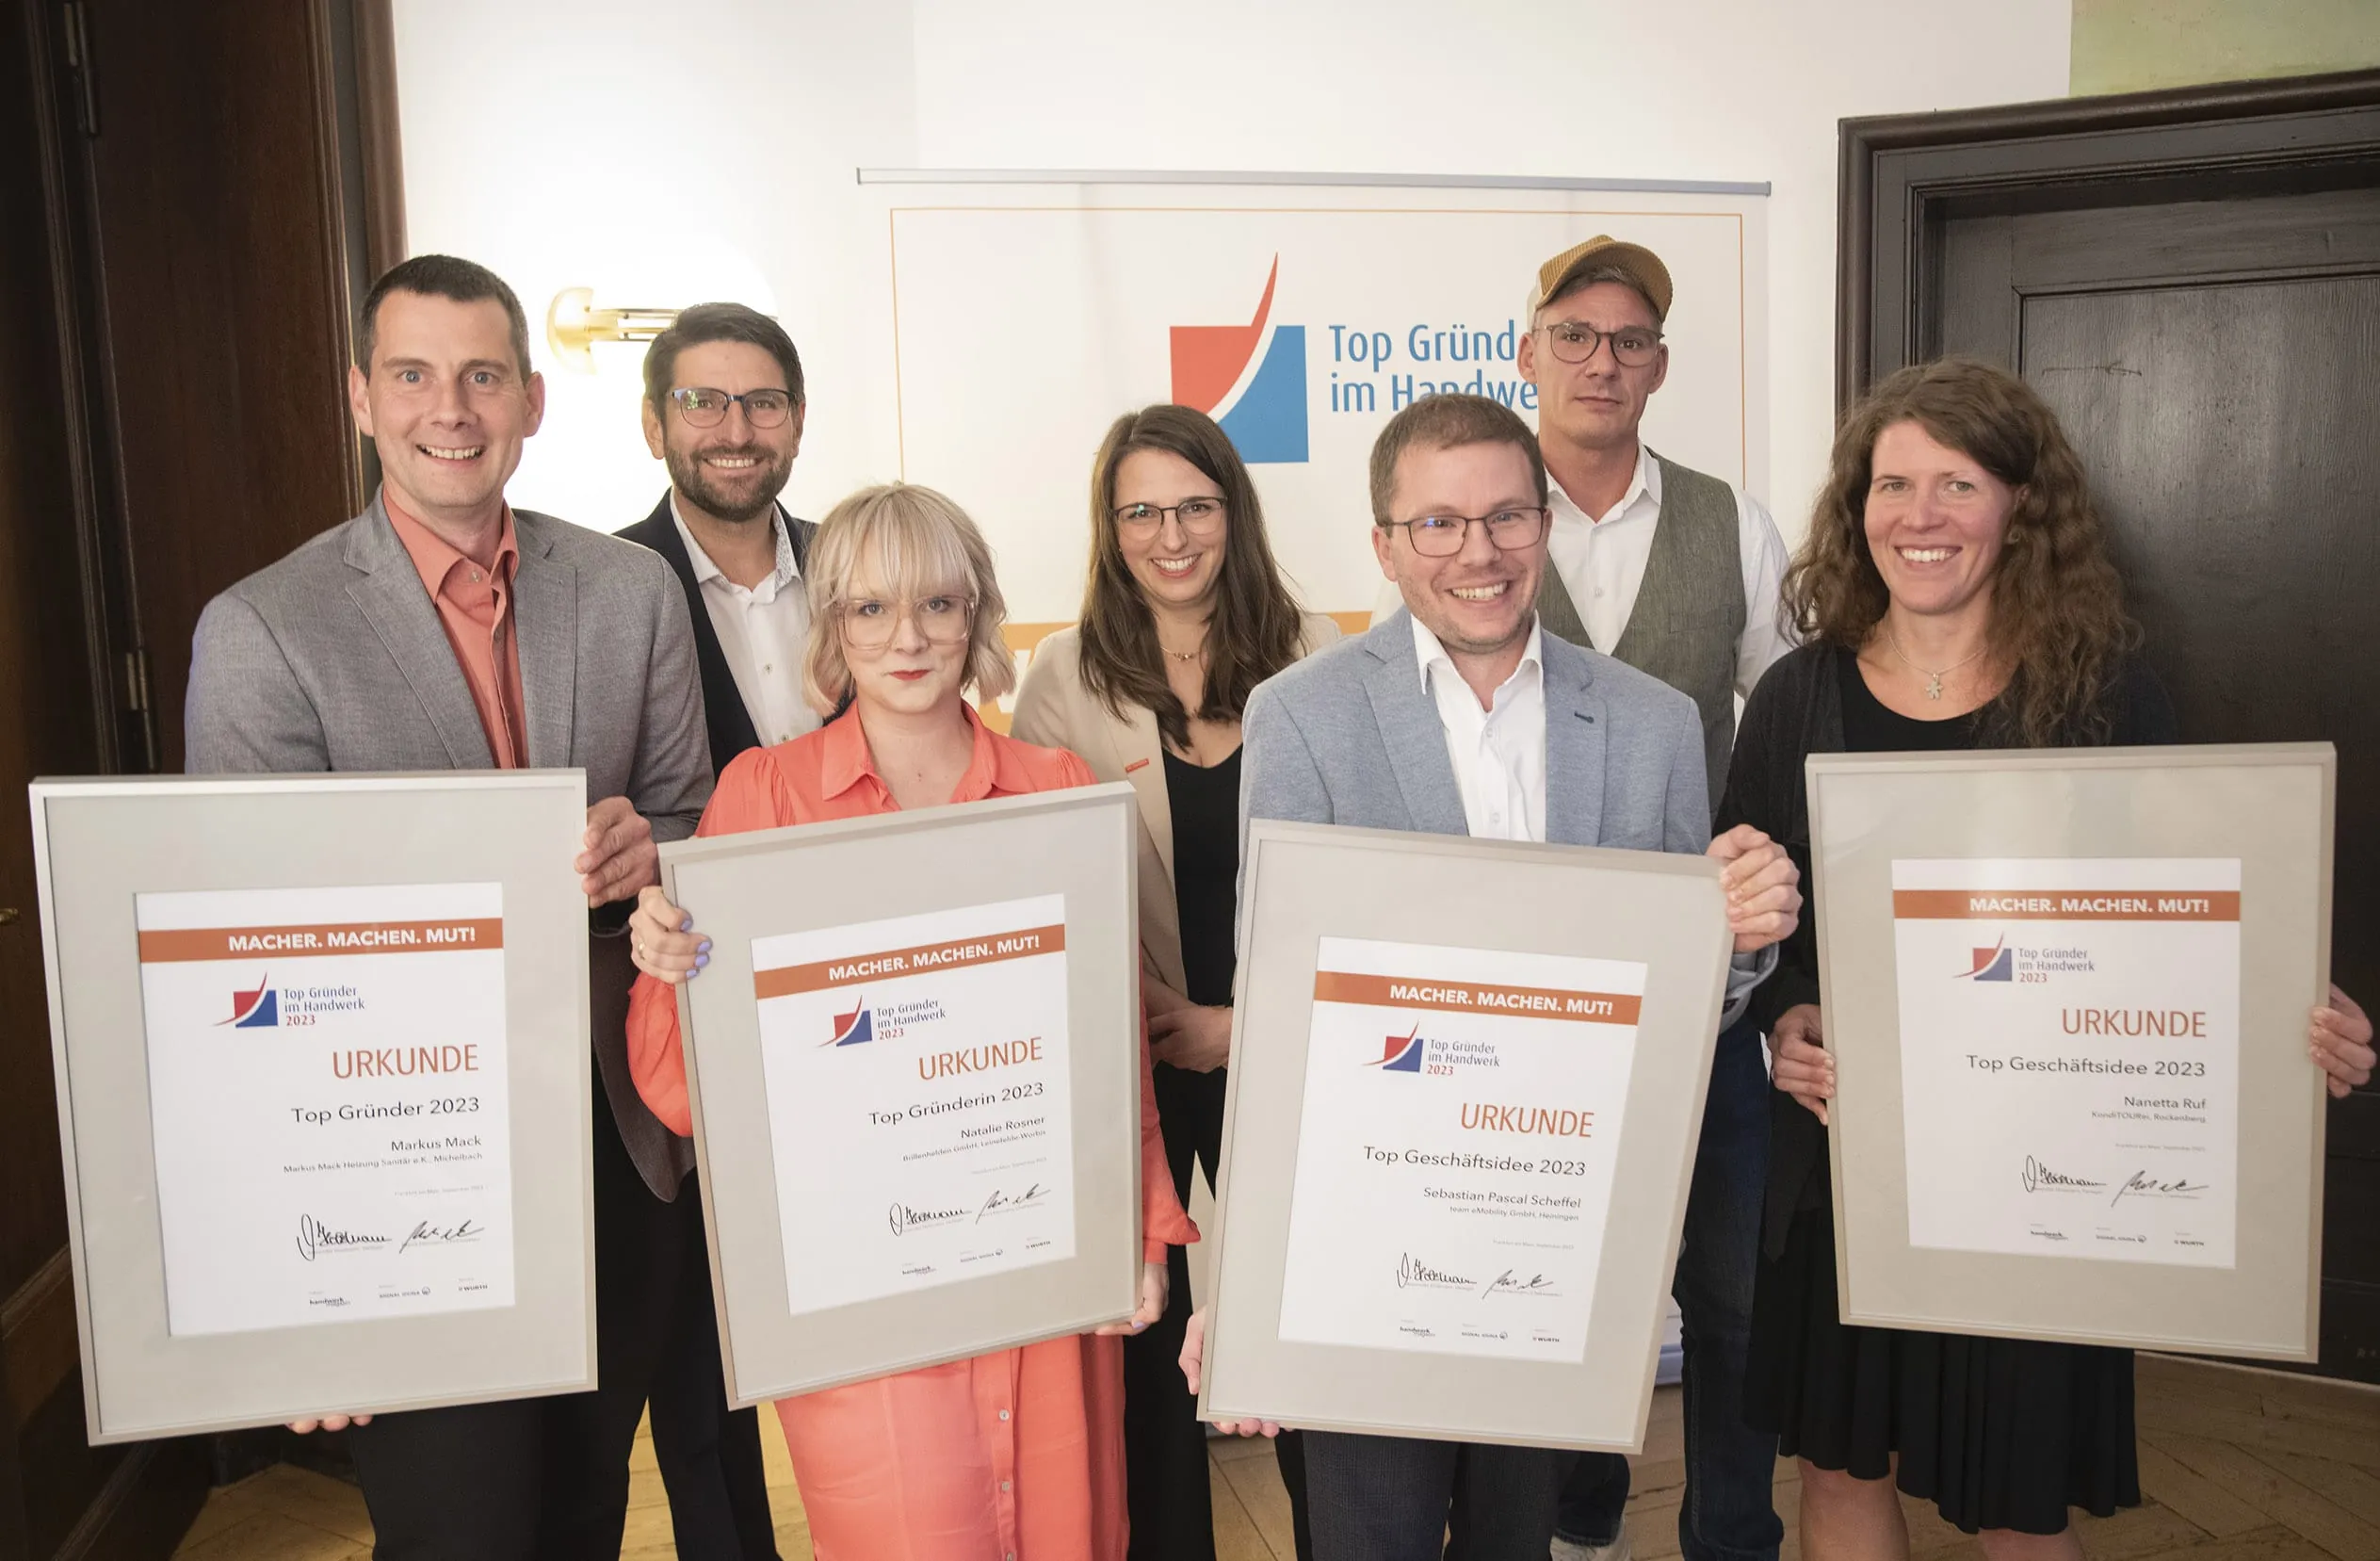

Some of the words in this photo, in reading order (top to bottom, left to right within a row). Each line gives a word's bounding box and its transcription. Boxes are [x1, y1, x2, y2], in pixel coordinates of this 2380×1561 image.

[1329, 325, 1392, 372] Top
[1408, 319, 1515, 362] Gründ
[1331, 372, 1375, 412] im
[1969, 897, 2057, 913] MACHER.
[2061, 897, 2153, 914] MACHEN.
[2158, 898, 2210, 914] MUT!
[228, 933, 322, 951] MACHER.
[327, 930, 421, 948] MACHEN.
[426, 927, 476, 944] MUT!
[829, 957, 909, 982] MACHER.
[913, 943, 994, 968] MACHEN.
[996, 935, 1040, 954] MUT!
[2018, 948, 2038, 961] Top
[2042, 947, 2088, 959] Gründer
[2018, 961, 2033, 970] im
[2036, 960, 2096, 971] Handwerk
[2019, 972, 2048, 983] 2023
[283, 988, 304, 1001] Top
[309, 984, 357, 998] Gründer
[1389, 984, 1473, 1005] MACHER.
[1477, 991, 1562, 1013] MACHEN.
[1566, 999, 1613, 1016] MUT!
[284, 1001, 300, 1013] im
[303, 998, 365, 1012] Handwerk
[877, 1006, 895, 1018] Top
[898, 998, 939, 1014] Gründer
[286, 1014, 316, 1027] 2023
[877, 1018, 891, 1029] im
[894, 1007, 947, 1026] Handwerk
[2063, 1009, 2207, 1037] URKUNDE
[879, 1028, 904, 1041] 2023
[1430, 1038, 1449, 1052] Top
[1452, 1040, 1496, 1054] Gründer
[332, 1044, 479, 1080] URKUNDE
[918, 1036, 1043, 1081] URKUNDE
[1428, 1051, 1442, 1063] im
[1446, 1053, 1500, 1067] Handwerk
[1967, 1055, 2003, 1072] Top
[2010, 1056, 2148, 1075] Geschäftsidee
[2154, 1061, 2207, 1077] 2023
[1427, 1065, 1454, 1076] 2023
[291, 1108, 332, 1126] Top
[338, 1100, 424, 1121] Gründer
[429, 1097, 480, 1114] 2023
[868, 1111, 903, 1127] Top
[908, 1093, 996, 1119] Gründerin
[1001, 1081, 1044, 1102] 2023
[2124, 1096, 2178, 1109] Nanetta
[2182, 1098, 2207, 1110] Ruf
[961, 1123, 1002, 1139] Natalie
[1005, 1115, 1045, 1131] Rosner
[1461, 1102, 1595, 1138] URKUNDE
[391, 1137, 442, 1152] Markus
[445, 1135, 482, 1148] Mack
[283, 1164, 316, 1174] Markus
[317, 1162, 341, 1171] Mack
[1364, 1146, 1399, 1166] Top
[1404, 1148, 1534, 1173] Geschäftsidee
[1540, 1159, 1587, 1177] 2023
[1423, 1186, 1484, 1202] Sebastian
[1487, 1191, 1528, 1205] Pascal
[1530, 1195, 1581, 1209] Scheffel
[1449, 1206, 1469, 1214] team
[1471, 1207, 1508, 1218] eMobility
